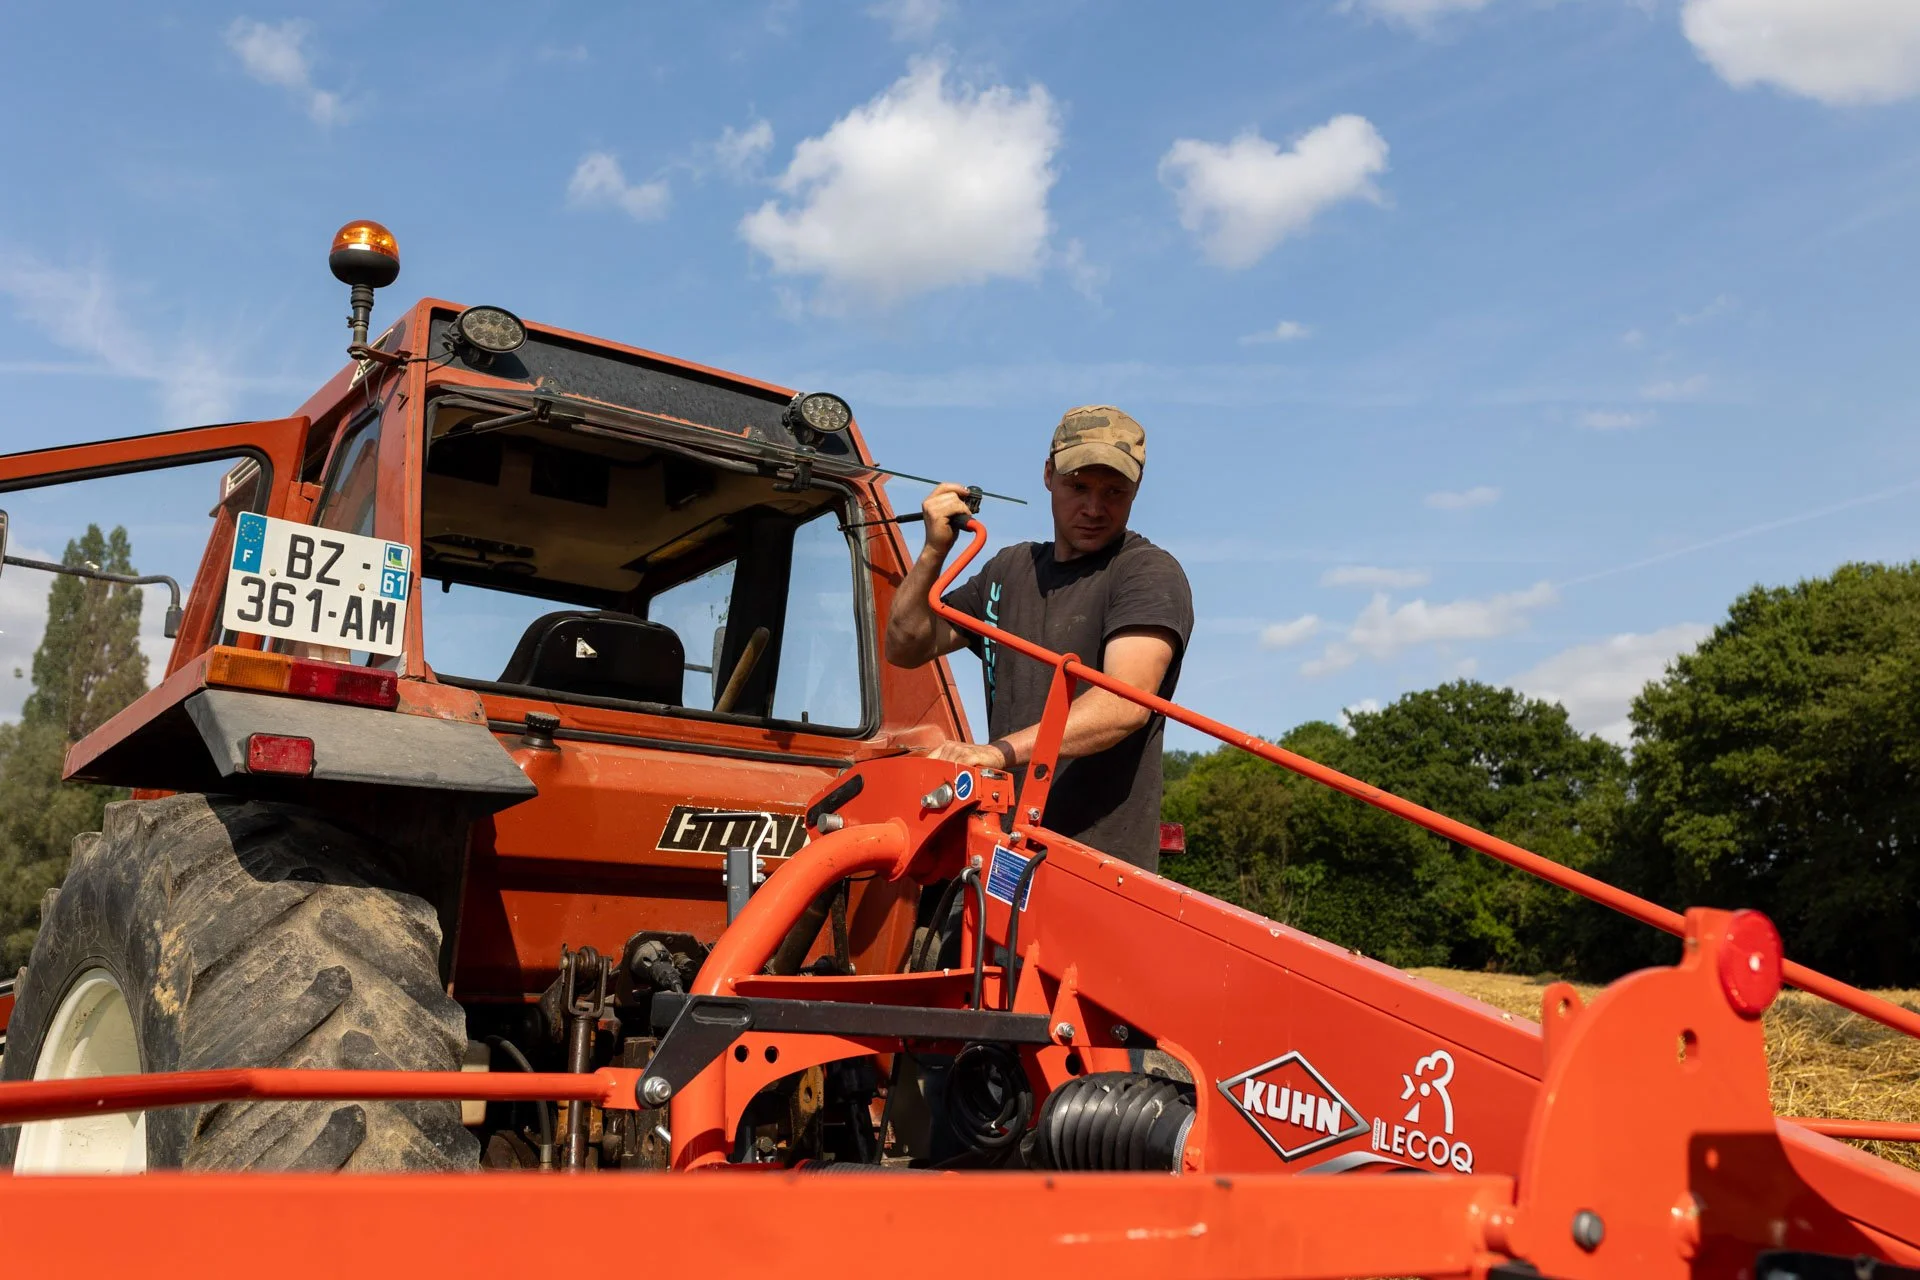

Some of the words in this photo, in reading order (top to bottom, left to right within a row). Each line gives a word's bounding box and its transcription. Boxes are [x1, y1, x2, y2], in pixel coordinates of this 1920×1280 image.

[242, 549, 253, 563] F
[382, 572, 405, 595] 61
[236, 575, 397, 645] 361-AM
[672, 812, 811, 850] FIA
[1243, 1077, 1342, 1137] KUHN
[1379, 1120, 1474, 1174] LECOQ
